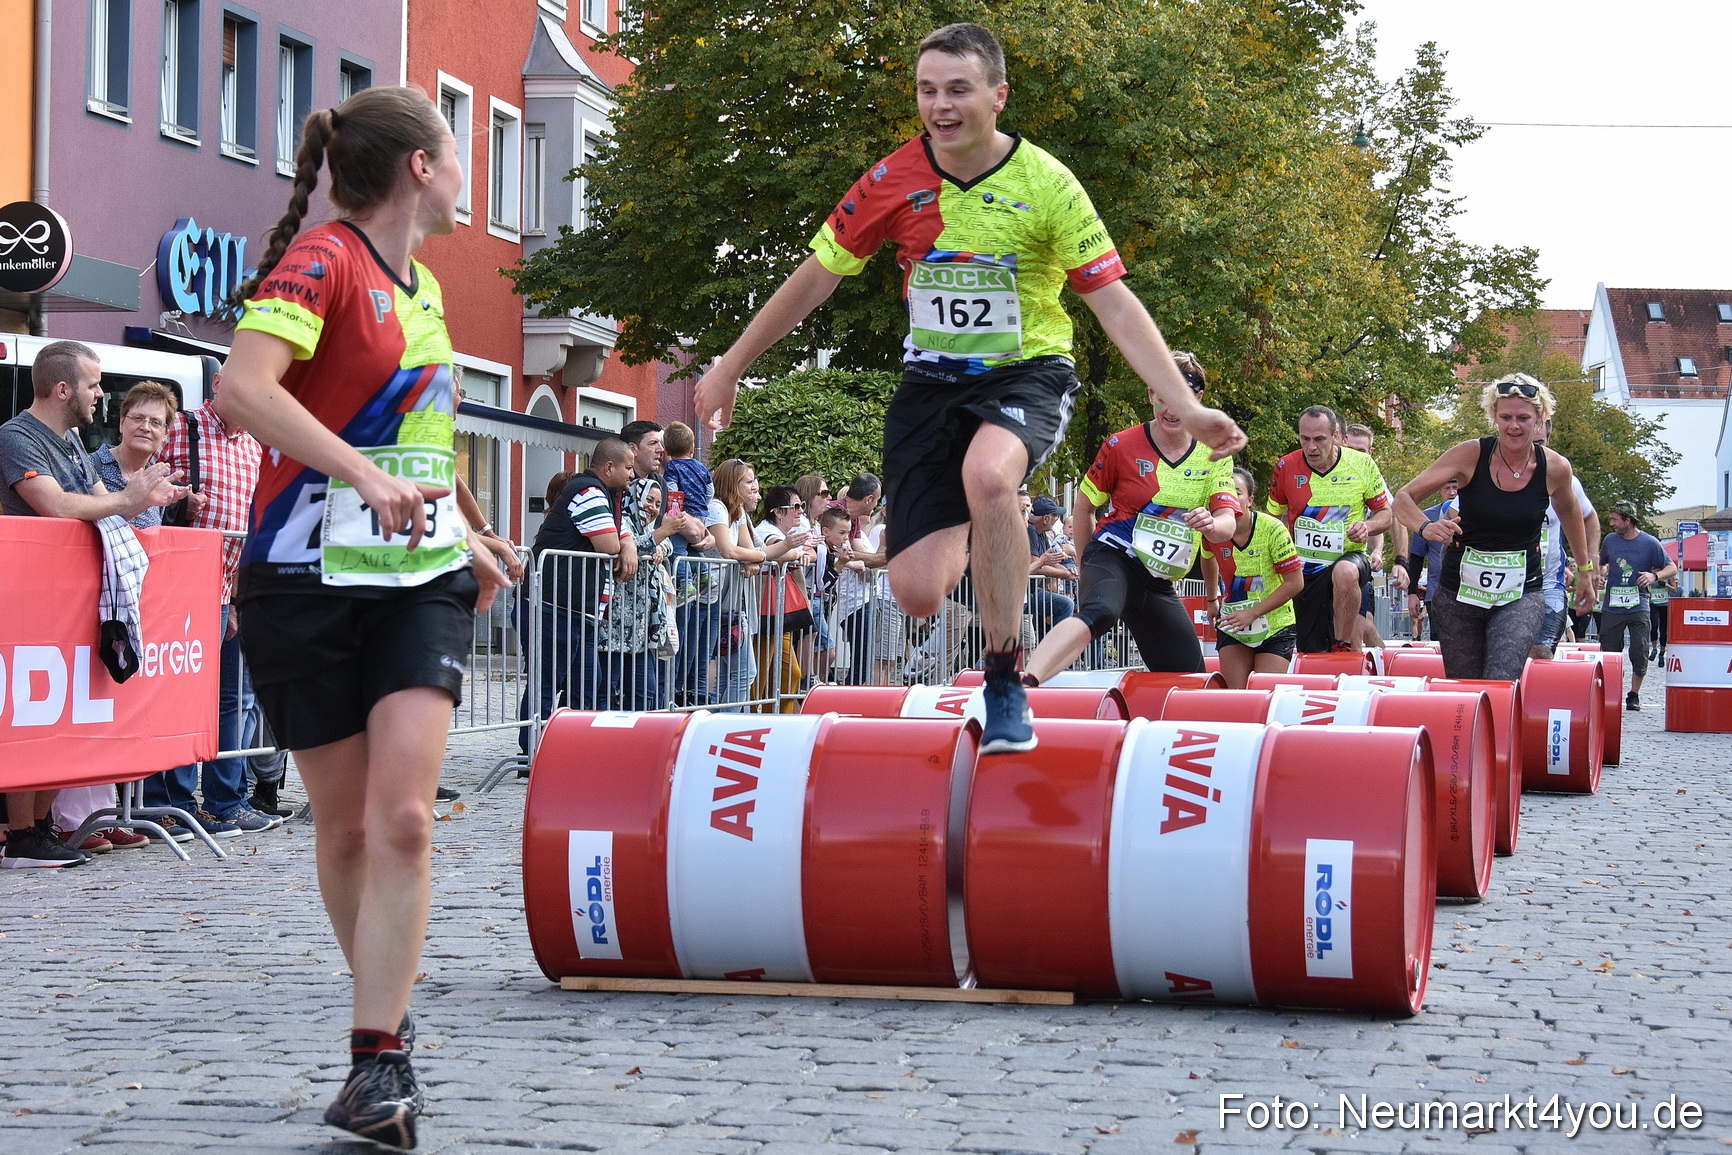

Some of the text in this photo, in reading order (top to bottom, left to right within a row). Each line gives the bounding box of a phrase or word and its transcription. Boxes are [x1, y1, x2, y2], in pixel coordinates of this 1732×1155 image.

[915, 266, 1000, 287] BOCK
[930, 296, 993, 328] 162
[927, 335, 956, 350] NICO
[372, 456, 447, 482] OCK
[1151, 539, 1180, 561] 87
[1305, 532, 1332, 549] 164
[340, 550, 409, 571] LAURA
[1146, 558, 1171, 574] ULLA
[1468, 553, 1521, 567] BOCK
[1479, 571, 1506, 589] 67
[0, 645, 115, 727] DL
[603, 856, 612, 901] energie
[1305, 916, 1315, 959] energie
